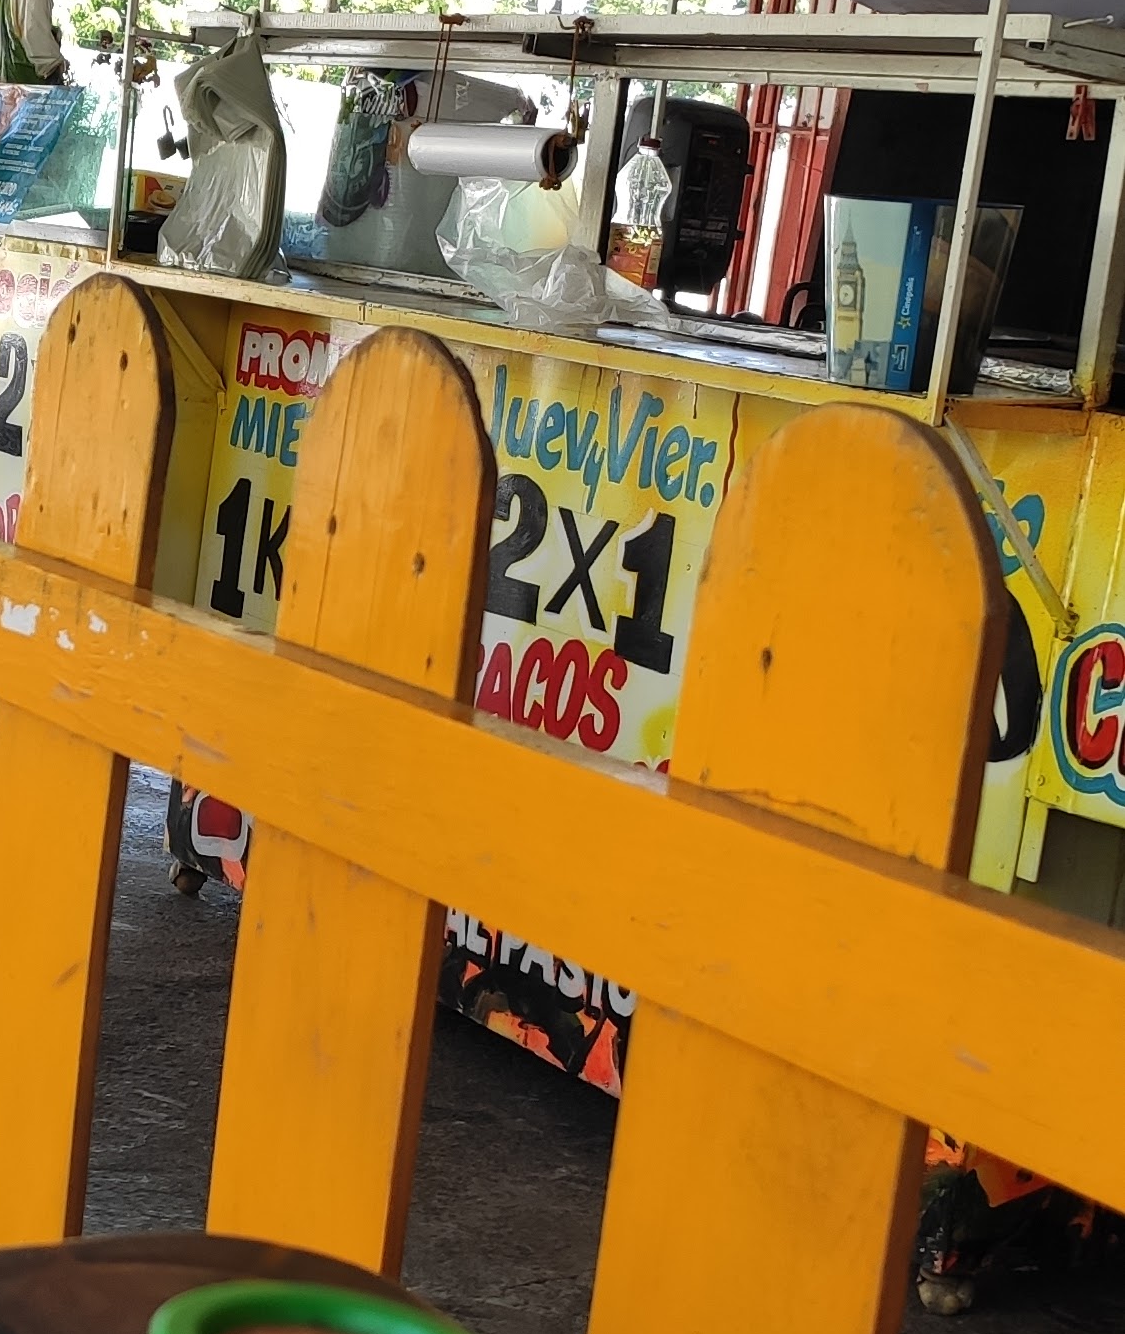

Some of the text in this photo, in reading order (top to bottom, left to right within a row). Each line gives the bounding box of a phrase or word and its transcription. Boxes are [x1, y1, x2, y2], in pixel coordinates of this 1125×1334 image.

[603, 384, 718, 507] Vier.
[477, 637, 628, 753] ACOS
[1066, 640, 1125, 773] C
